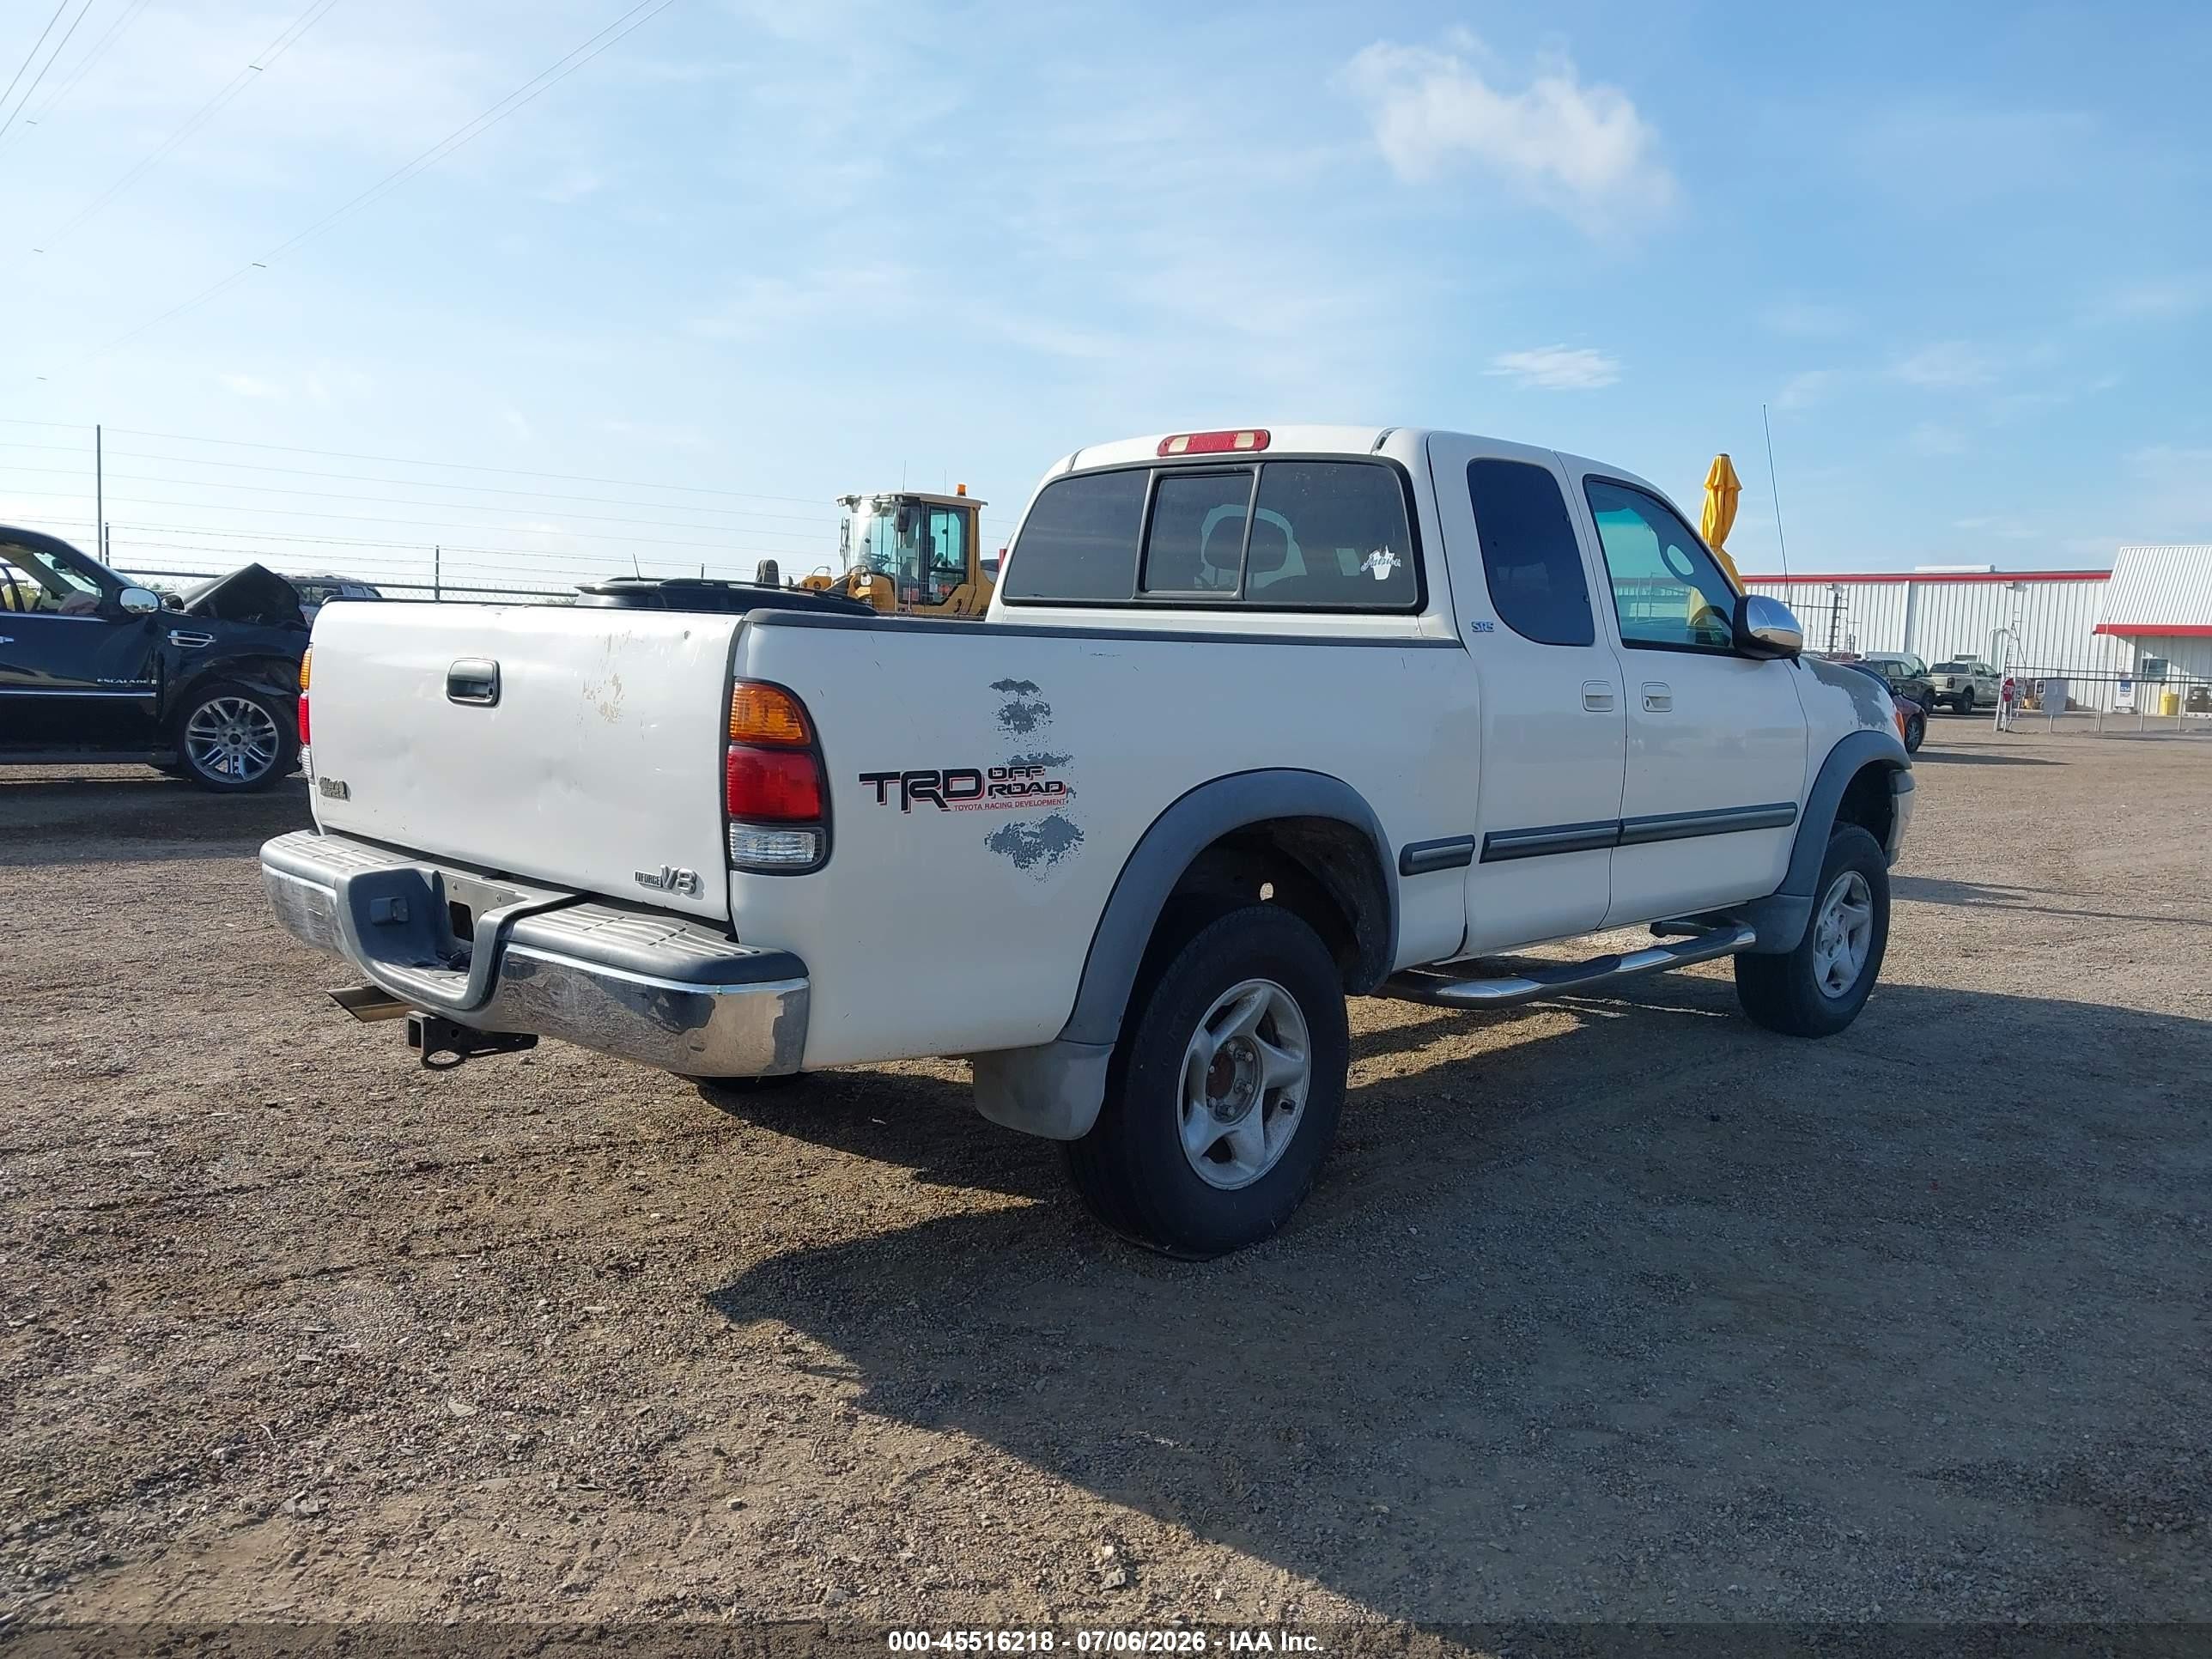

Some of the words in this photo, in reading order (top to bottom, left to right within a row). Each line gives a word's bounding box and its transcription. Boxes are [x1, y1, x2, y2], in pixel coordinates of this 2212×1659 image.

[988, 765, 1046, 782] OFF
[859, 768, 986, 814] TRD
[988, 781, 1066, 799] ROAD
[954, 803, 983, 811] TOYOTA
[984, 801, 1013, 810] RACING
[1014, 798, 1066, 807] DEVELOPMENT
[660, 864, 696, 895] V8
